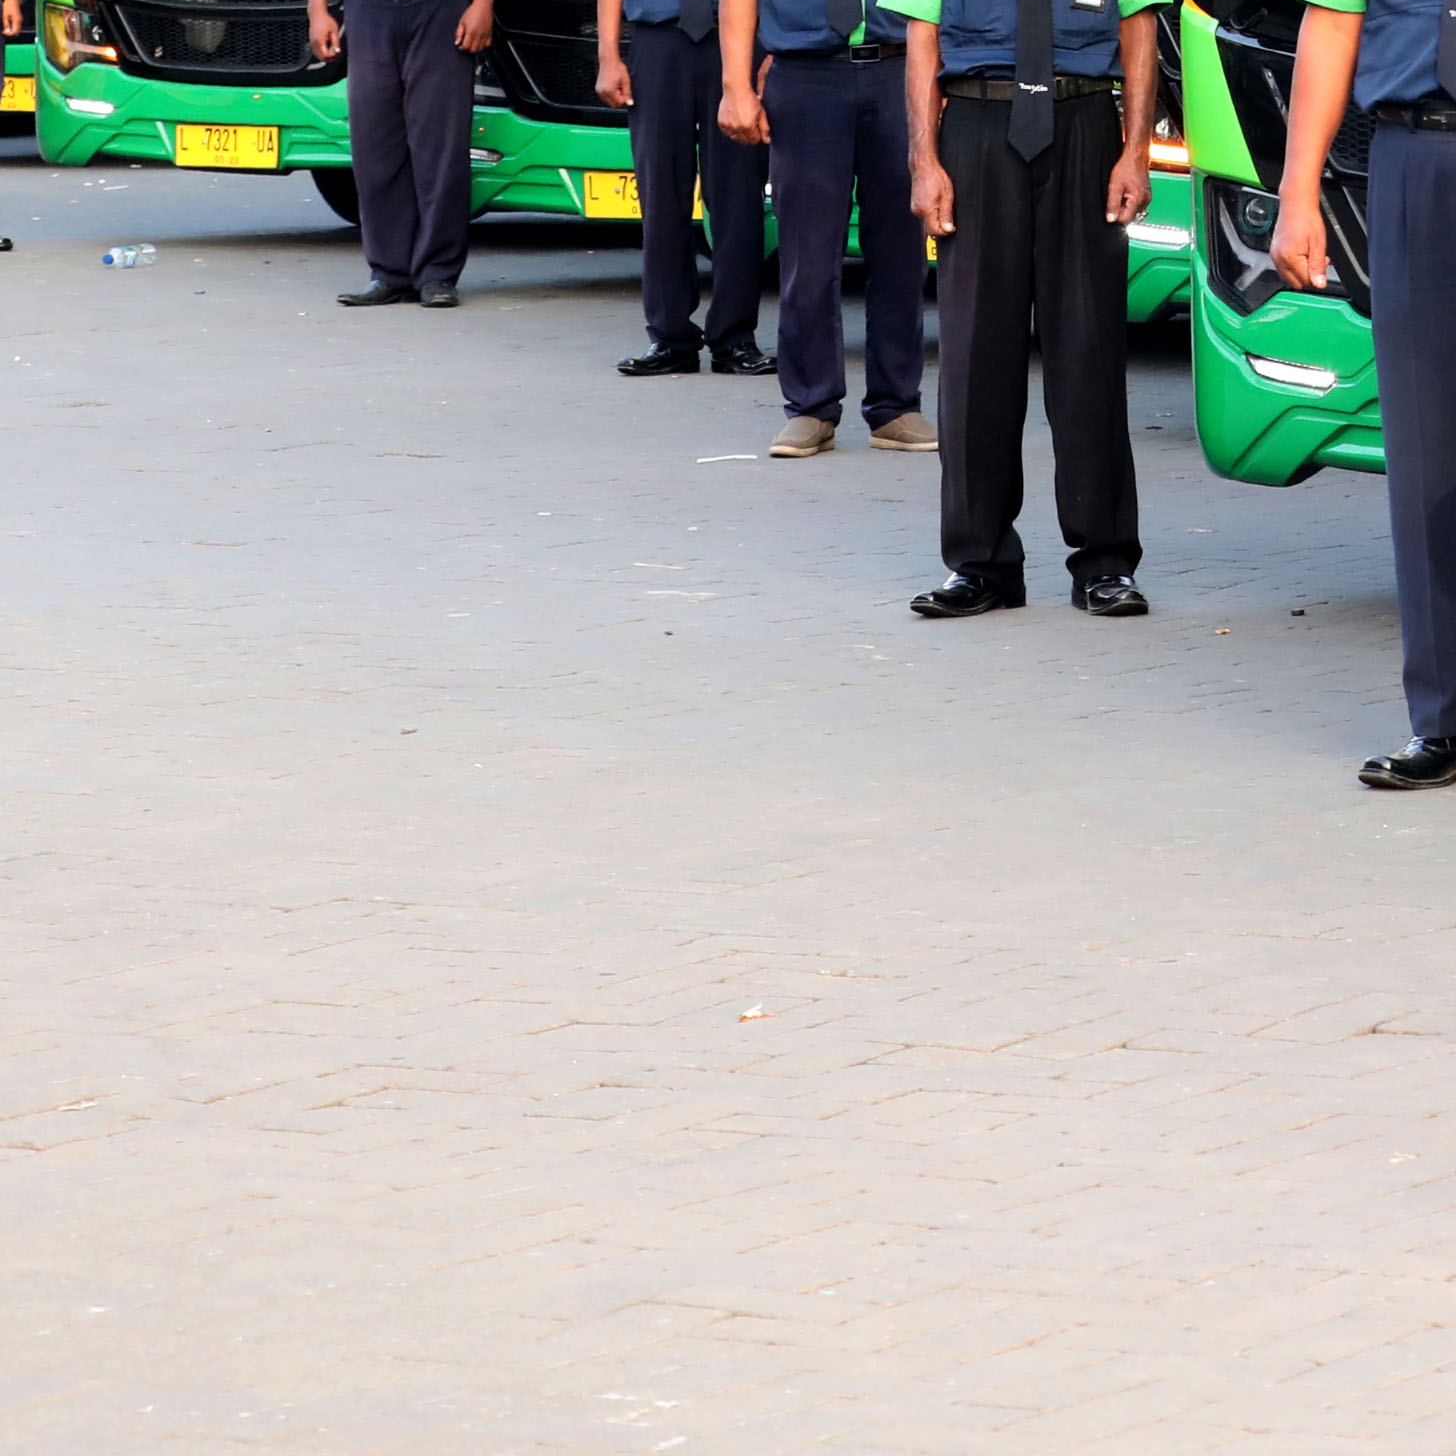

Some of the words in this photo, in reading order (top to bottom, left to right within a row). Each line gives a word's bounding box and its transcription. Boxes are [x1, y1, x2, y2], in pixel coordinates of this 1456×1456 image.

[179, 127, 189, 152] L
[205, 127, 238, 153] 7321
[257, 129, 274, 153] UA
[588, 175, 599, 201] L
